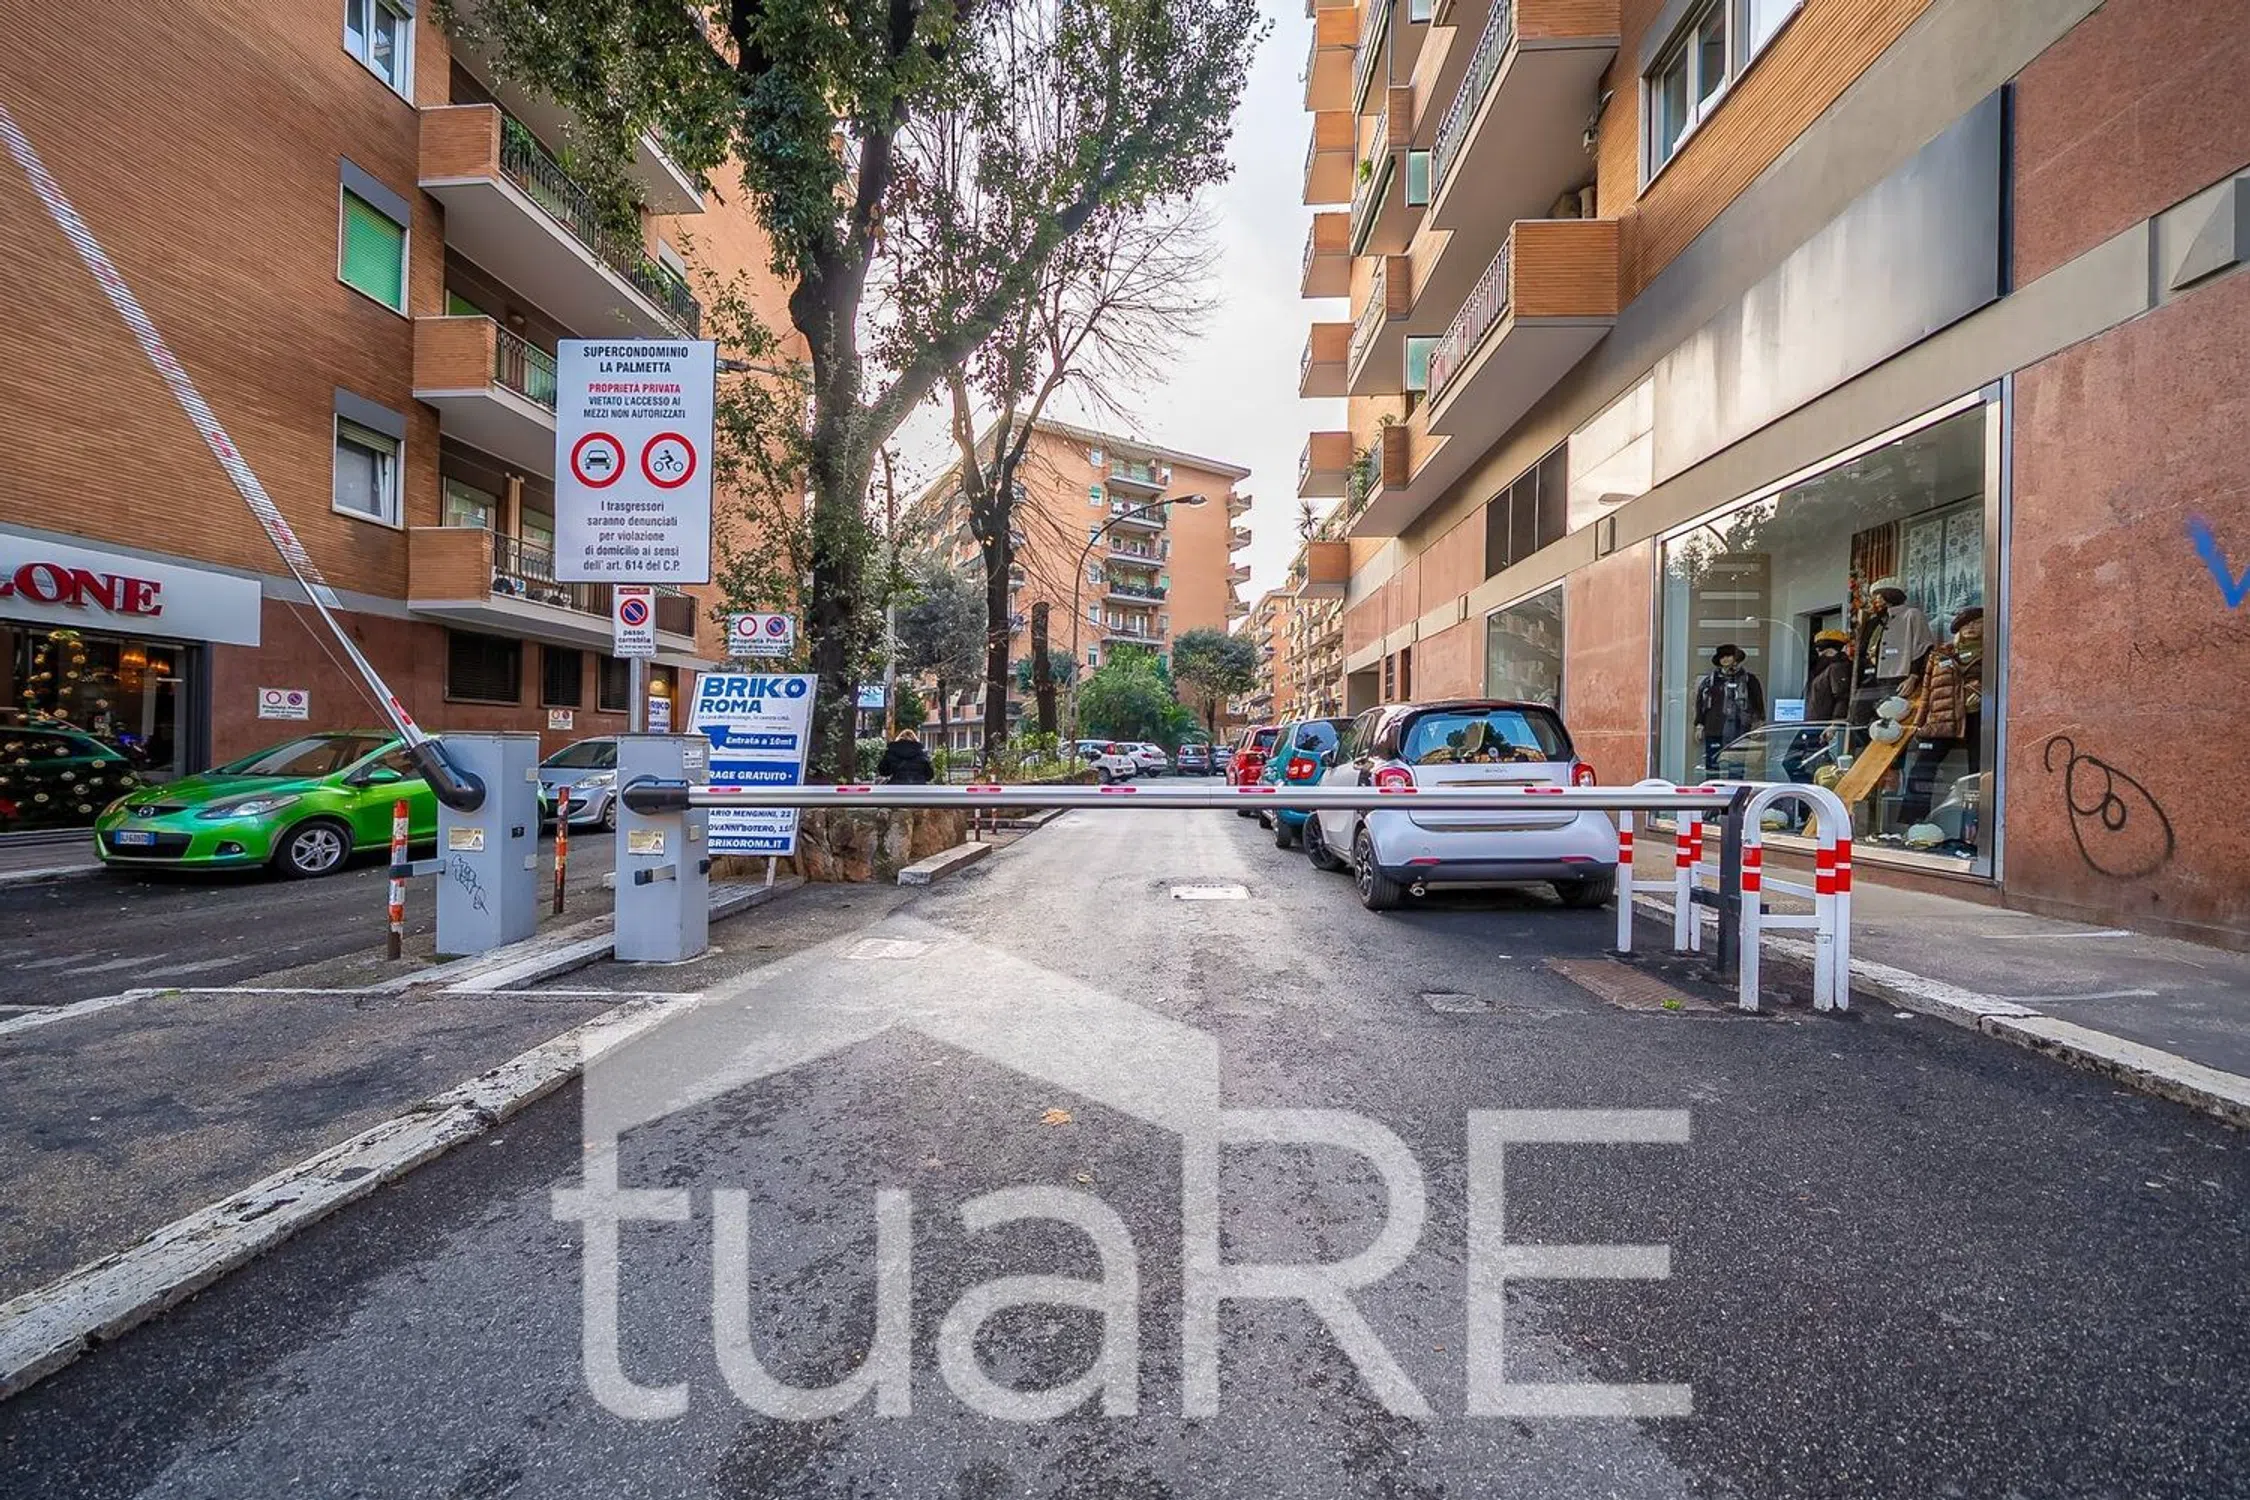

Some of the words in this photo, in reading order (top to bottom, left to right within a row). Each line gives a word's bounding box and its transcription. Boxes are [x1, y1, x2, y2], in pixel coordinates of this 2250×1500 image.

[583, 346, 689, 358] SUPERCONDOMINIO
[600, 361, 613, 373] LA
[616, 361, 672, 373] PALMETTA
[642, 383, 681, 393] PRIVATA
[588, 396, 622, 406] VIETATO
[624, 396, 670, 406] L'ACCESSO
[672, 396, 681, 406] AI
[583, 409, 609, 418] MEZZI
[611, 409, 630, 418] NON
[631, 409, 686, 419] AUTORIZZATI
[607, 501, 664, 514] trasgressori
[587, 517, 625, 526] saranno
[628, 516, 678, 526] denunciati
[599, 532, 615, 542] per
[617, 530, 665, 541] violazione
[584, 545, 594, 556] di
[596, 545, 640, 556] domicilio
[642, 545, 651, 556] ai
[653, 545, 680, 556] sensi
[606, 560, 622, 571] art.
[625, 560, 643, 571] 614
[645, 560, 660, 571] del
[663, 560, 680, 571] C.P.
[0, 562, 163, 617] ONE
[702, 677, 807, 698] BRIKO
[700, 699, 762, 714] ROMA
[725, 736, 760, 745] Entrata
[769, 736, 792, 746] 10mt
[709, 771, 736, 780] RAGE
[737, 771, 787, 781] GRATUITO
[708, 824, 741, 832] OVANNI
